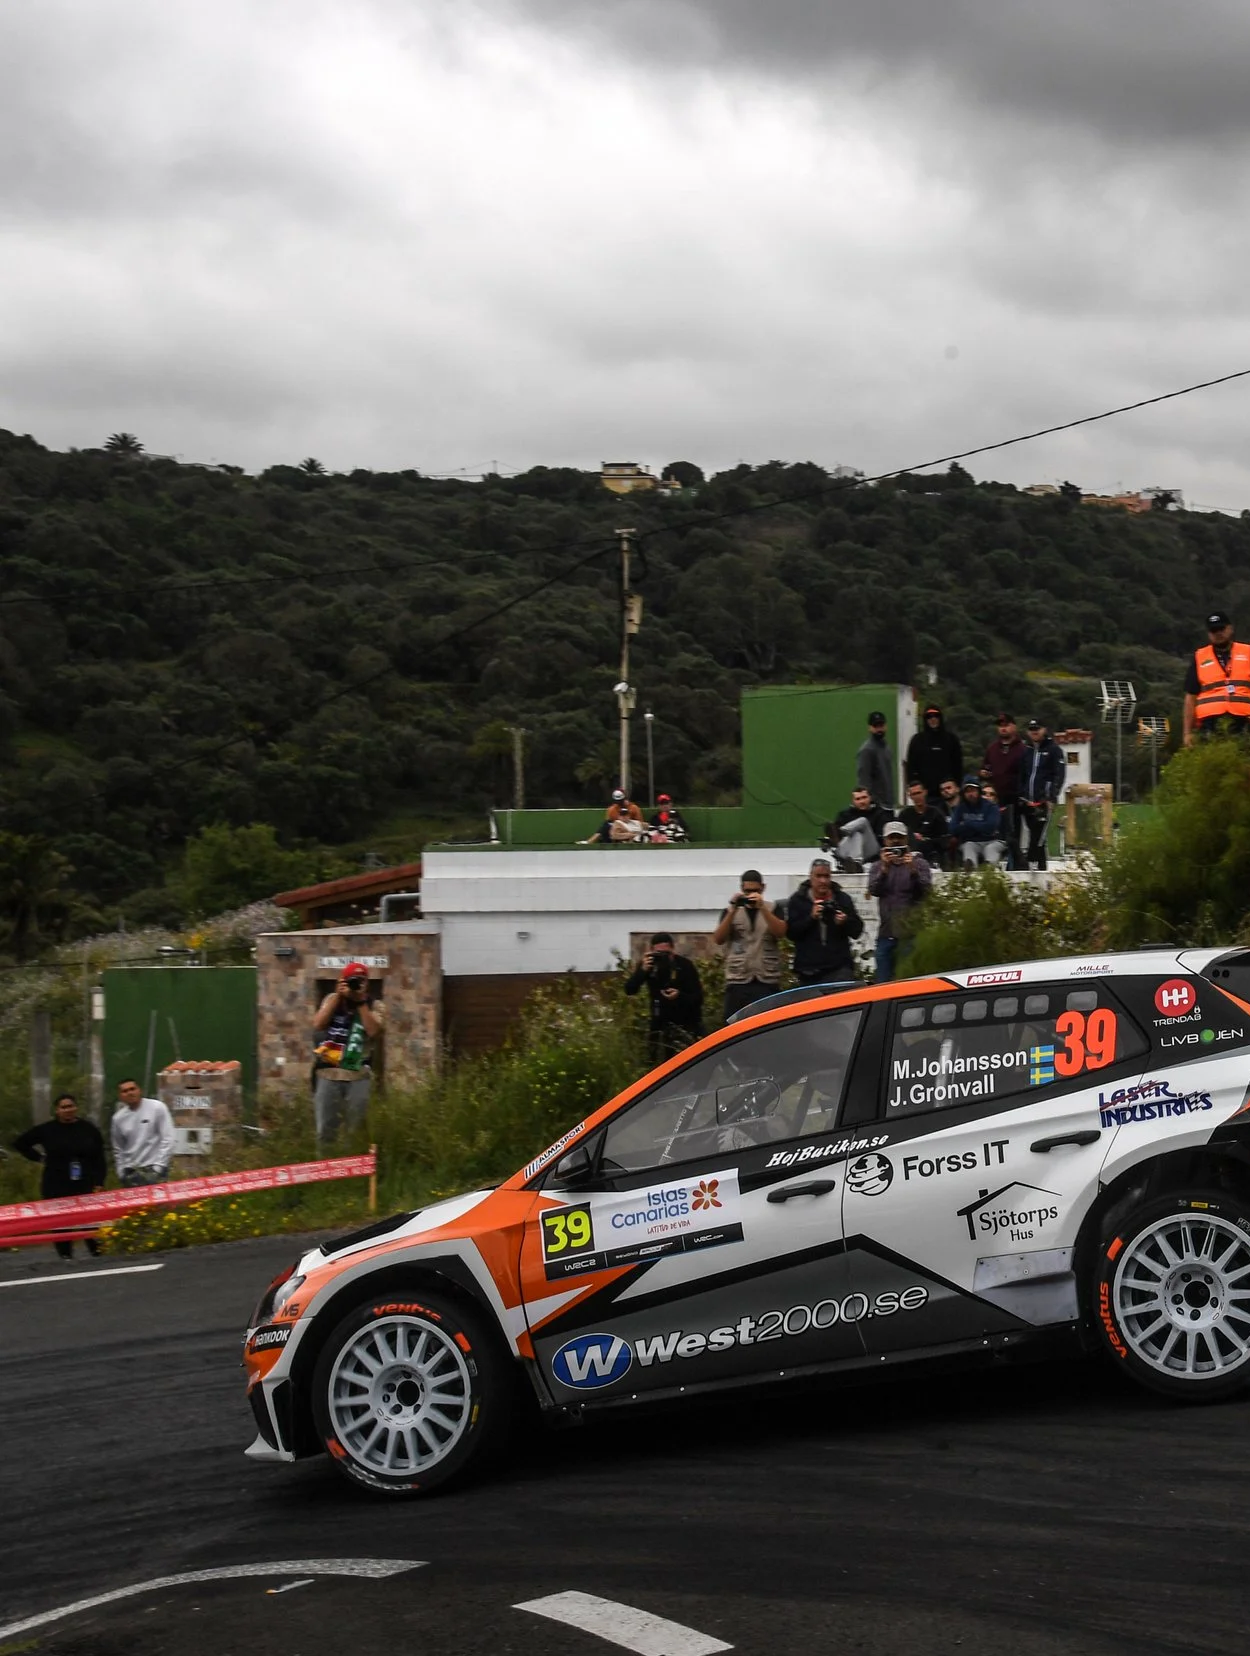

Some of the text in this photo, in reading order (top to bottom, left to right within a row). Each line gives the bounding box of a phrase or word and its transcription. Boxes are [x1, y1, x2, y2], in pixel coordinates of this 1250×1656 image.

[968, 971, 1021, 985] MOTUL
[1076, 964, 1110, 972] MILLE
[1152, 1013, 1202, 1027] TRENDAB
[1054, 1008, 1117, 1076] 39
[893, 1050, 1027, 1080] M.Johansson
[1100, 1091, 1213, 1128] INDUSTRIES
[539, 1123, 585, 1164] ALMASPORT
[765, 1133, 889, 1168] HojButiken.se
[903, 1139, 1010, 1181] Forss IT
[647, 1187, 688, 1207] Islas
[611, 1200, 689, 1229] Canarias
[670, 1222, 677, 1230] DE
[678, 1219, 691, 1228] VIDA
[979, 1206, 1058, 1235] Sjötorps
[544, 1210, 591, 1253] 39
[1010, 1229, 1034, 1241] Hus
[564, 1258, 596, 1271] WRC2
[634, 1286, 928, 1367] West2000.se
